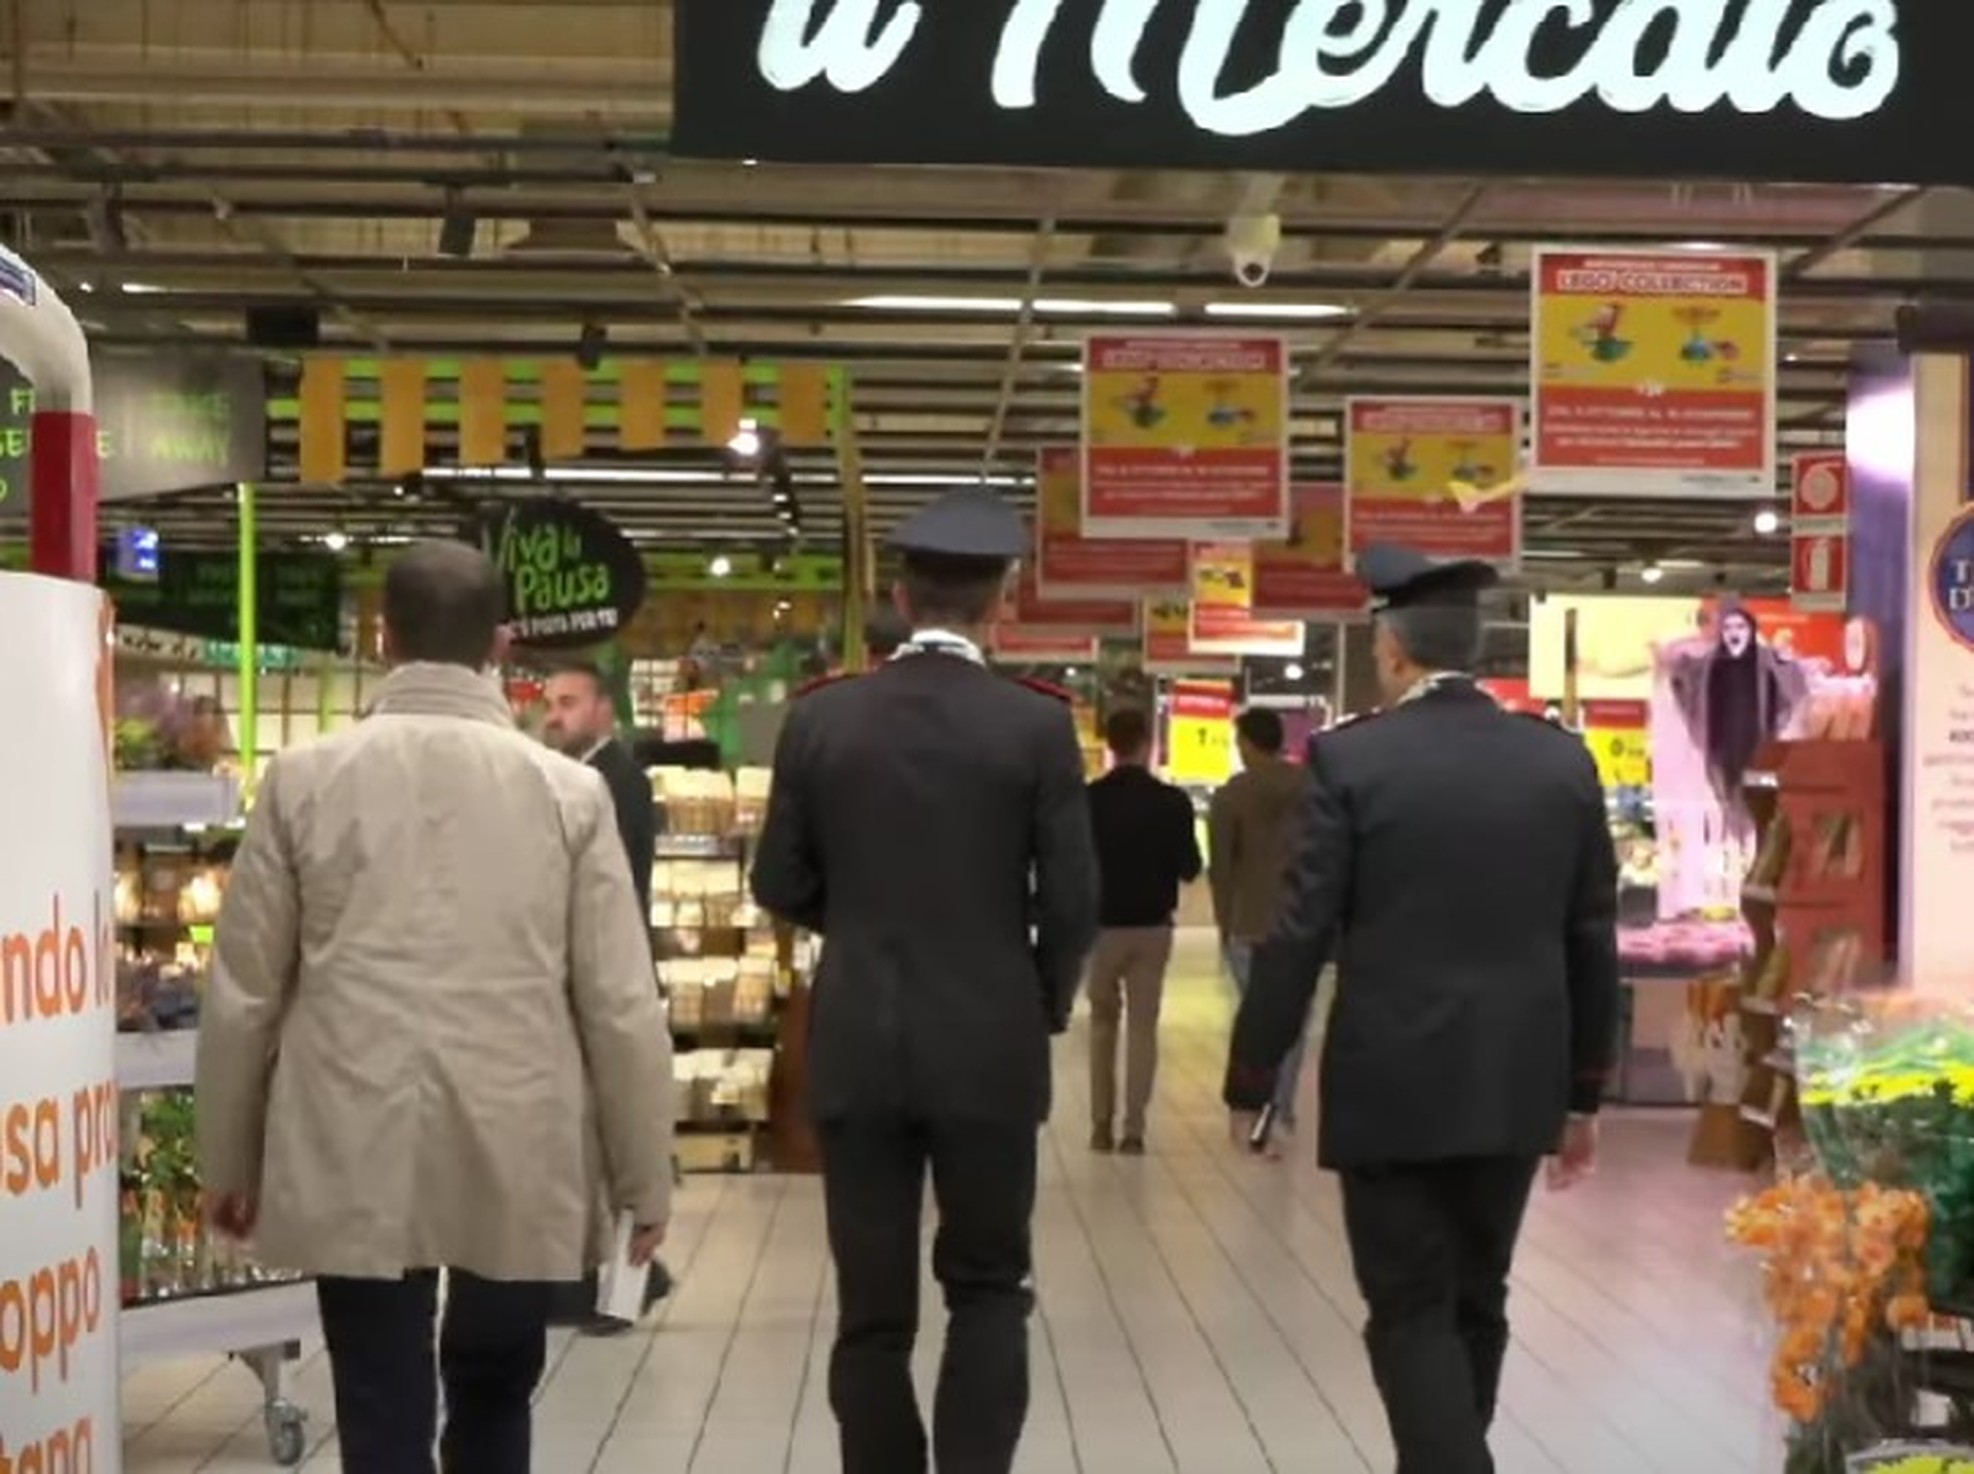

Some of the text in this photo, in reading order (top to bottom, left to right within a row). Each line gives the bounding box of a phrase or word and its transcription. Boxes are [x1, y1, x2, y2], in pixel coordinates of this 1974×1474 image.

[1559, 270, 1746, 293] LEGO COLLECTION
[515, 563, 610, 615] Pausa
[0, 1098, 60, 1196] sa
